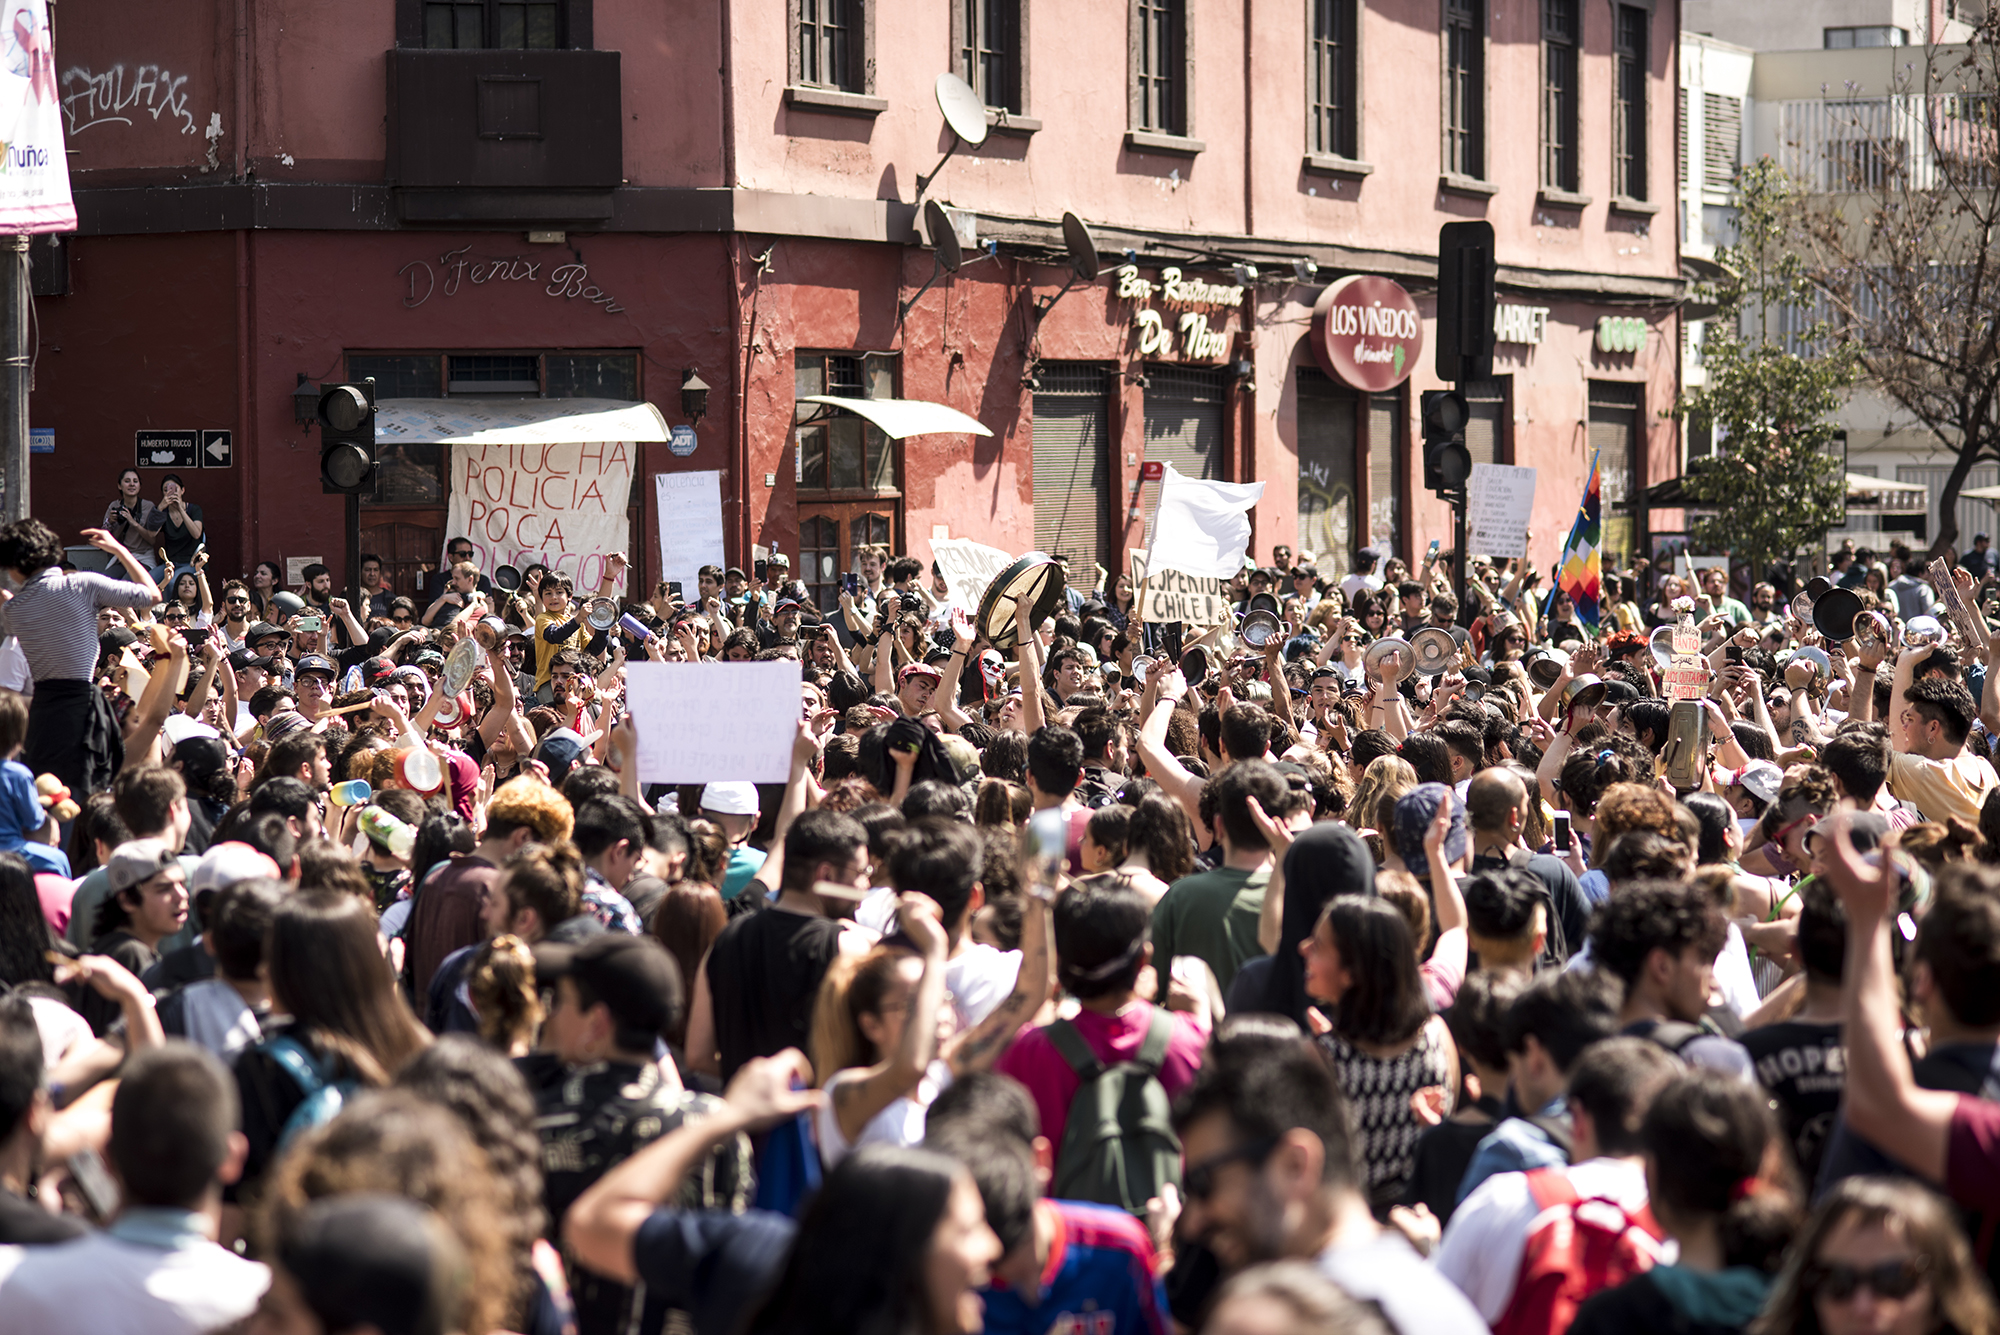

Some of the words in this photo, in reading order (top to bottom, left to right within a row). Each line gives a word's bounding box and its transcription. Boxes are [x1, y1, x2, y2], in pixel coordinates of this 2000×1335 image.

[545, 262, 626, 315] Bar
[1331, 304, 1357, 336] LOS
[1358, 300, 1417, 340] VIÑEDOS
[1136, 309, 1173, 355] De
[1179, 311, 1228, 359] Niro
[141, 439, 169, 448] HUMBERTO
[170, 439, 192, 448] TRUCCO
[672, 435, 693, 446] ADT
[140, 457, 149, 466] 123
[186, 457, 192, 465] 19
[481, 442, 629, 478] MUCHA
[465, 457, 607, 513] POLICIA
[468, 500, 566, 552] POCA
[1674, 637, 1699, 651] TANTO
[1666, 671, 1677, 684] NOS
[1678, 671, 1708, 685] QUITARON
[1673, 685, 1697, 699] MIEDO
